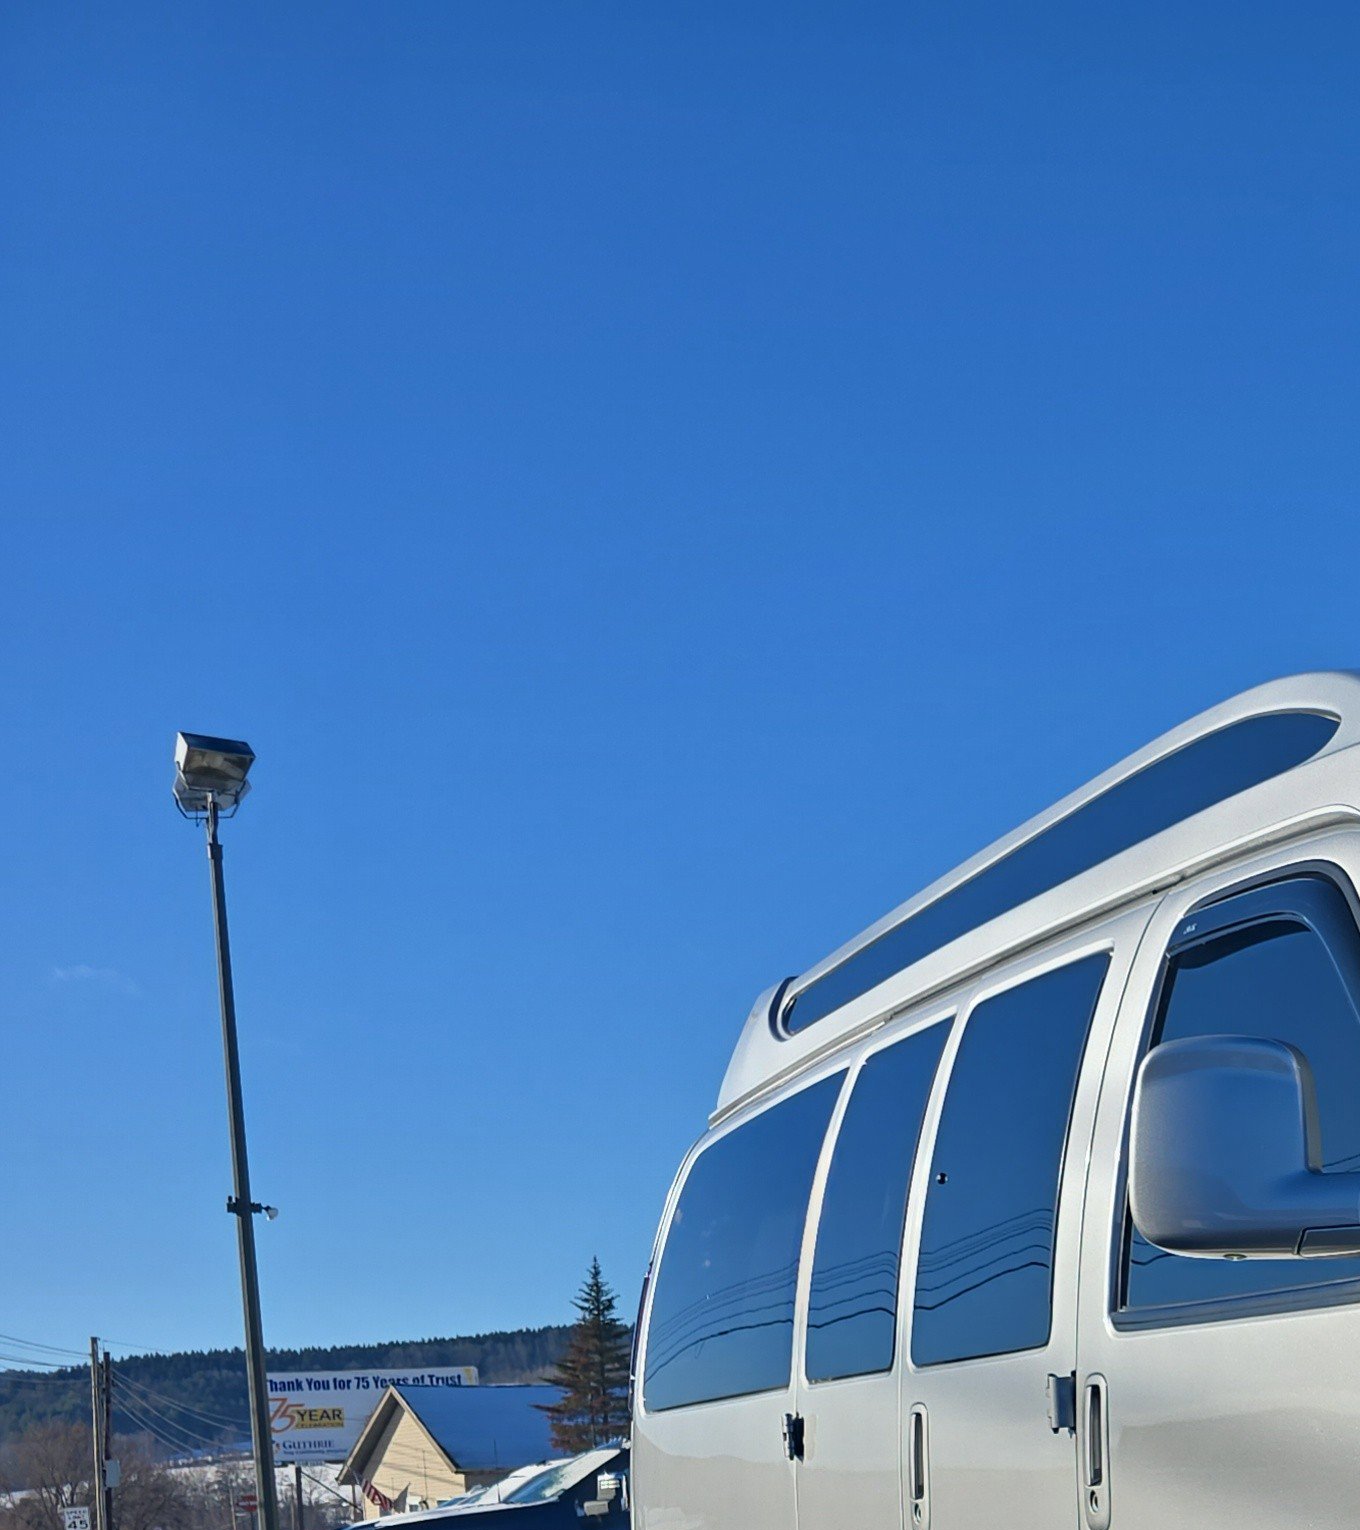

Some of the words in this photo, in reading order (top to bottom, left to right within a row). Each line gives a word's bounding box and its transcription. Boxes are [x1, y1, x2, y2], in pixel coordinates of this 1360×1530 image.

[305, 1378, 330, 1391] You
[333, 1377, 352, 1390] for
[354, 1377, 370, 1390] 75
[372, 1375, 408, 1389] Years
[412, 1374, 426, 1385] of
[428, 1374, 461, 1386] Trust
[268, 1398, 305, 1433] 75
[295, 1409, 343, 1421] YEAR
[68, 1520, 89, 1530] 45
